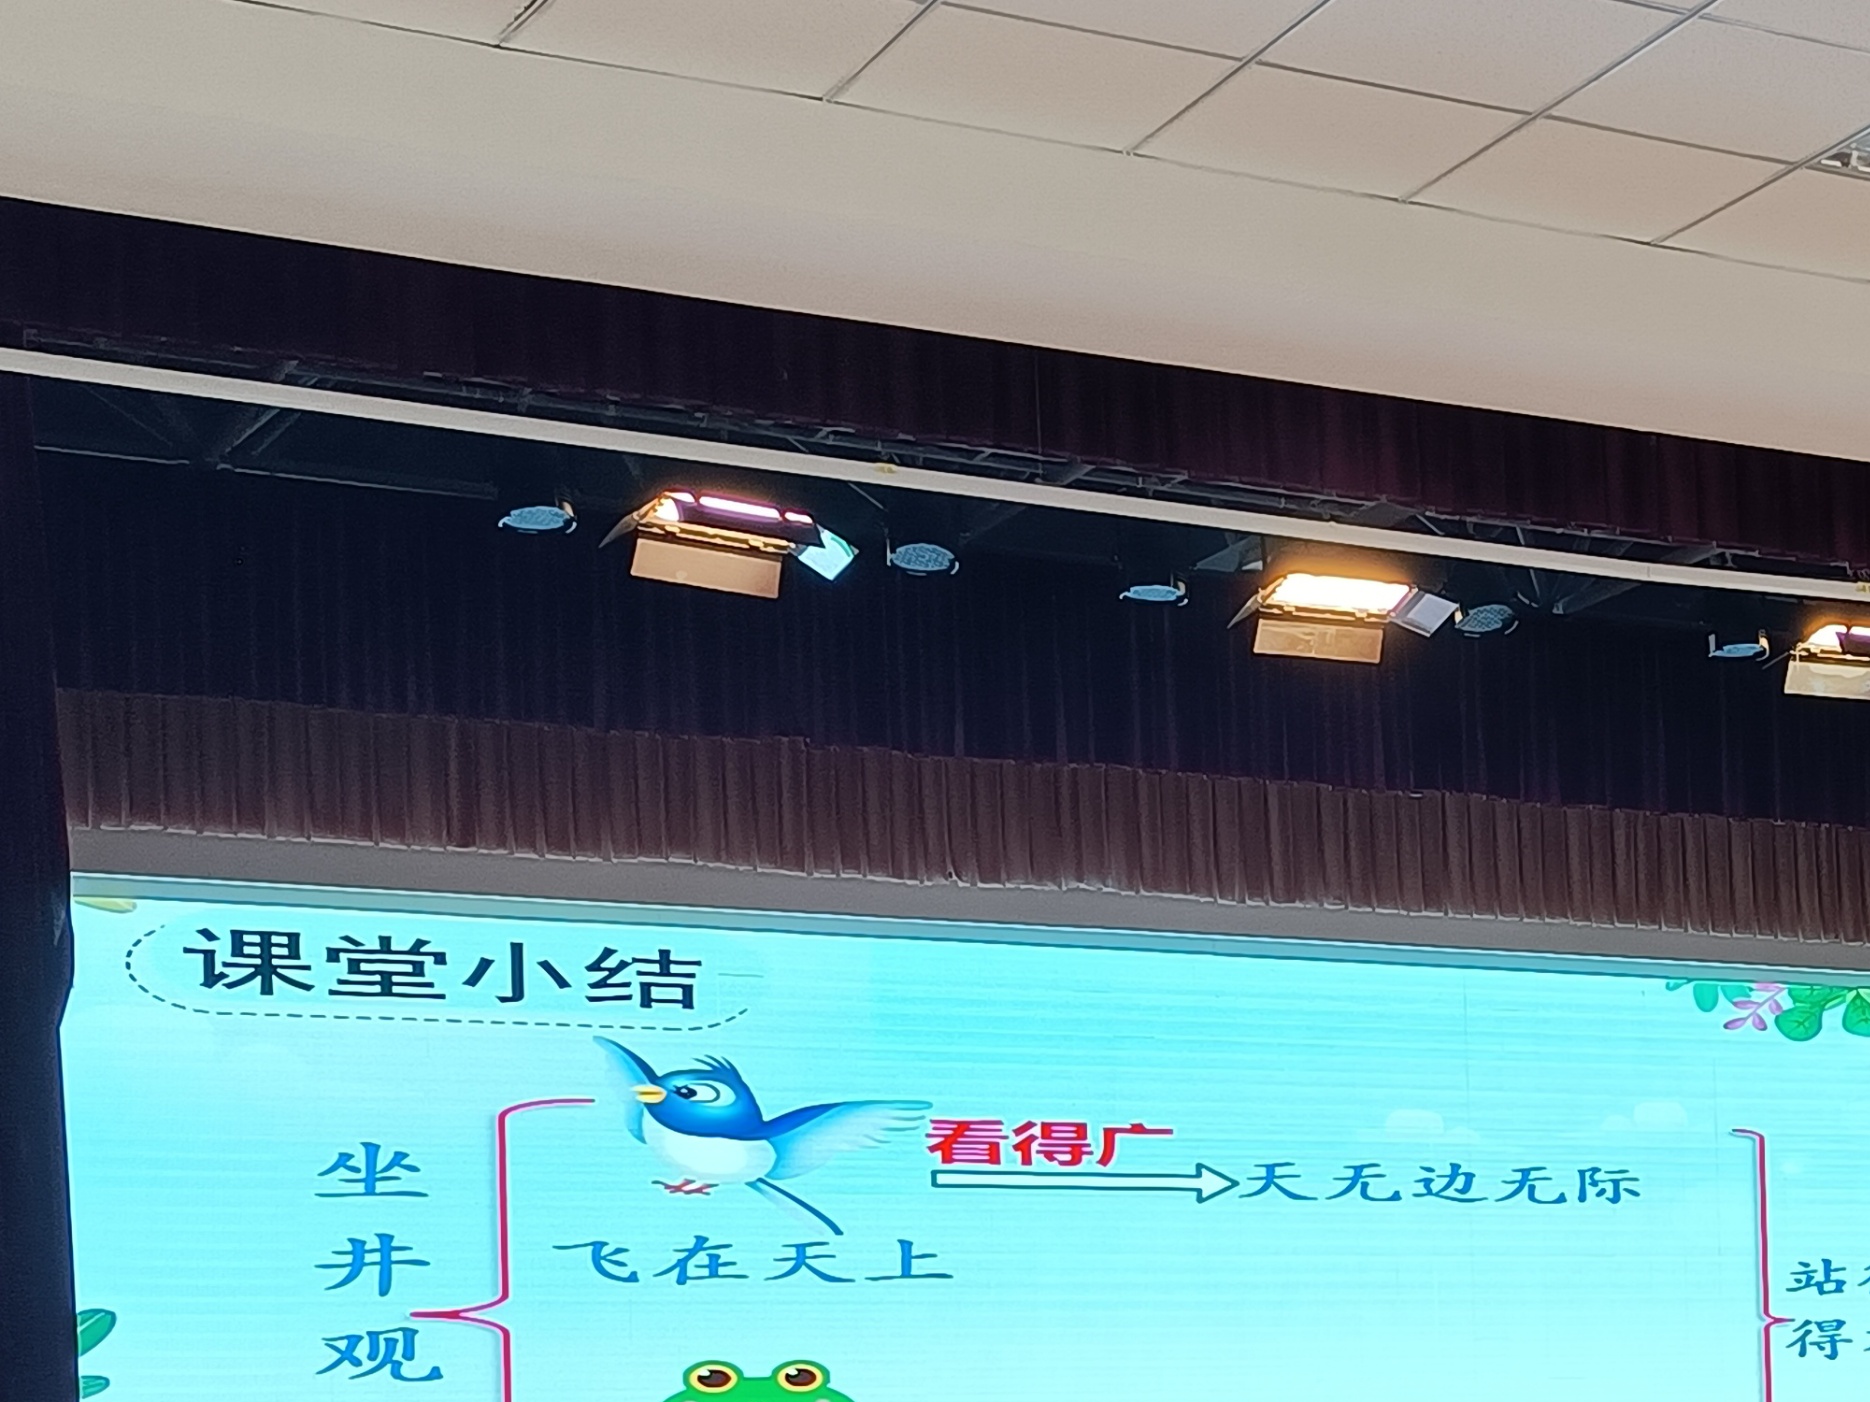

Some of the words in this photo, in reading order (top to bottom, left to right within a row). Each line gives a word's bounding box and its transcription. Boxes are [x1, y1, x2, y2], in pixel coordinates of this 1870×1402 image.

[183, 928, 702, 1010] 课堂小结
[925, 1117, 1174, 1167] 看得广
[1238, 1161, 1641, 1205] 天无边无际
[552, 1235, 954, 1286] 飞在天上
